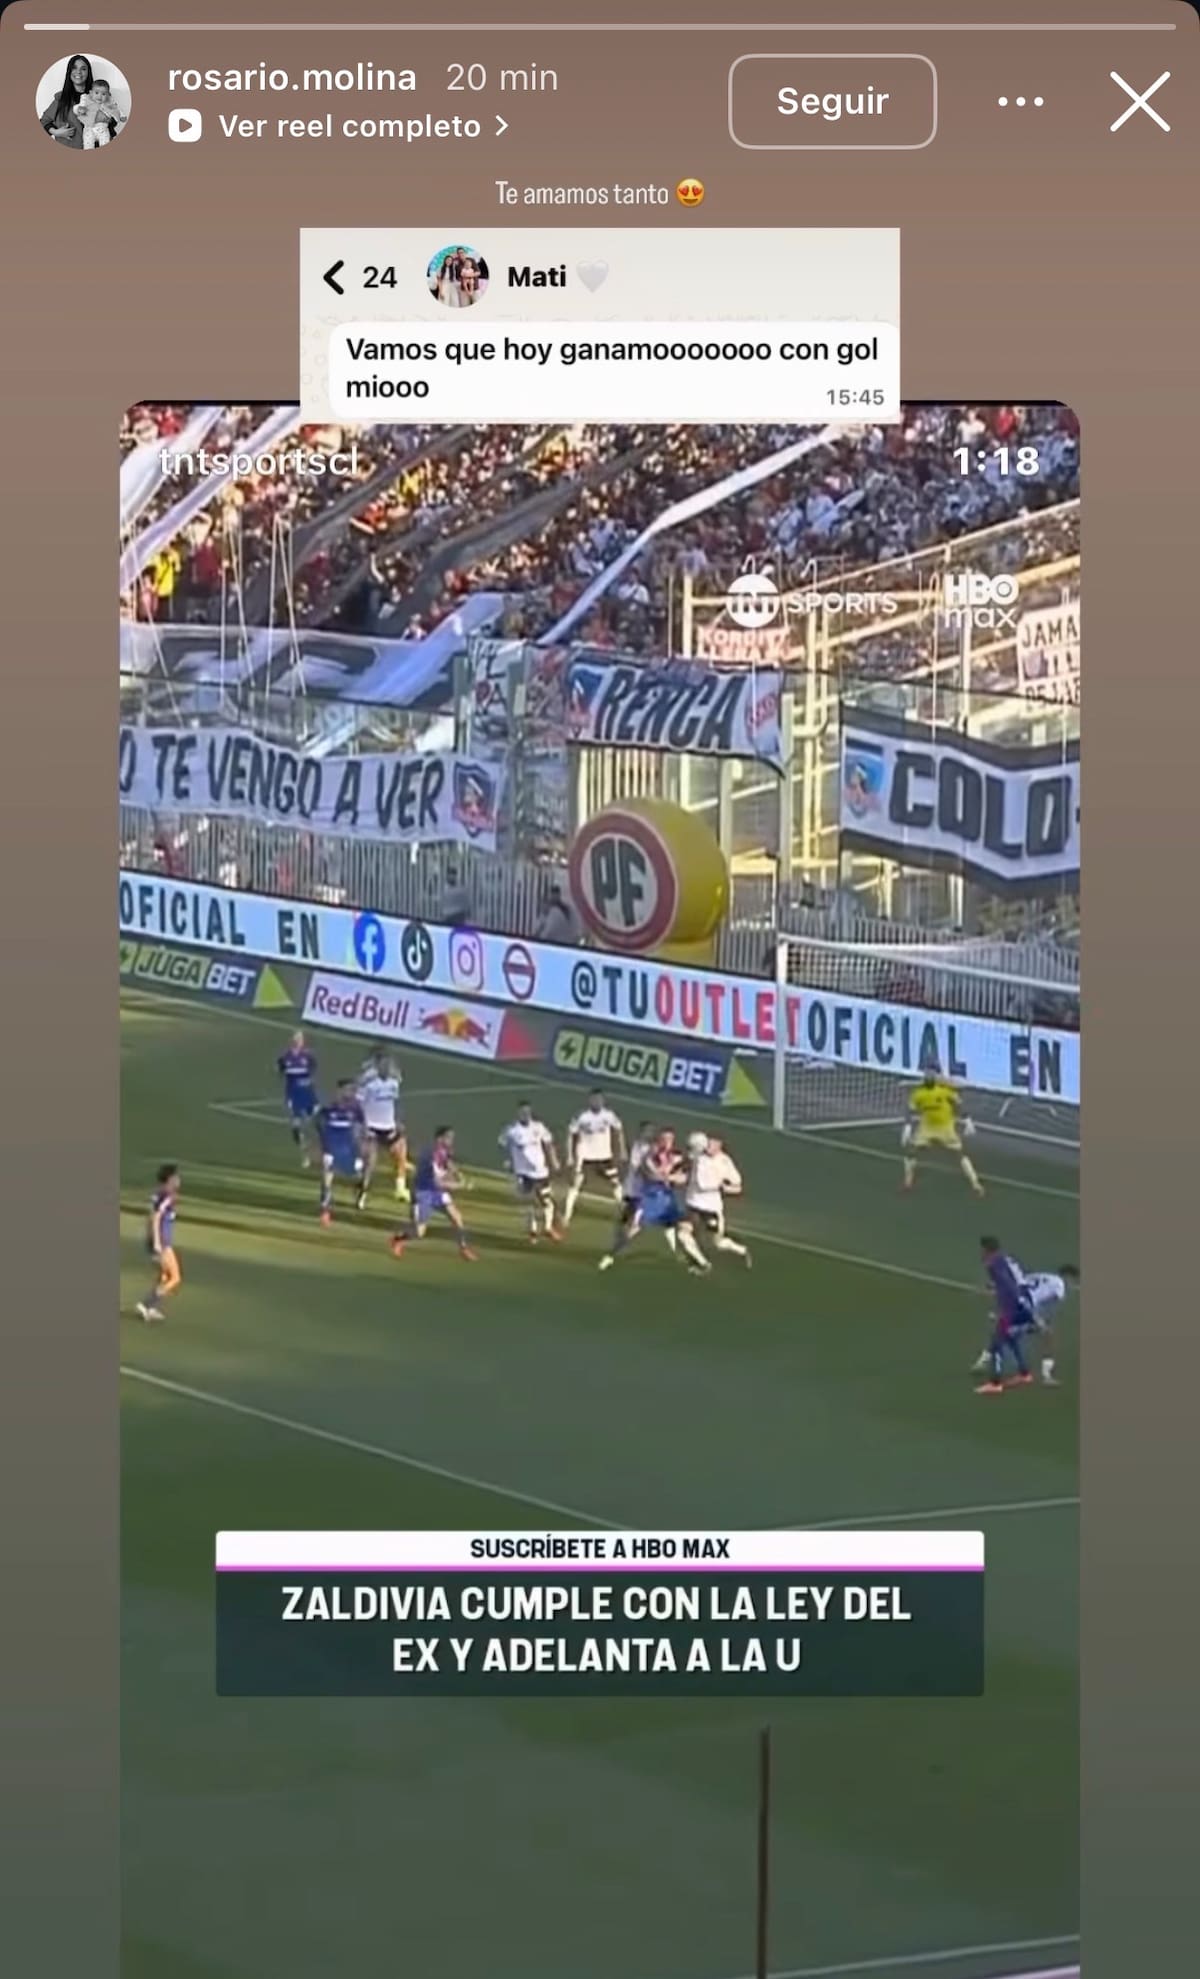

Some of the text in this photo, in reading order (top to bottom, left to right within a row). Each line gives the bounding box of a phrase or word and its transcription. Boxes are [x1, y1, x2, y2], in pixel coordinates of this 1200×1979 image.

[594, 666, 748, 750] RENCA
[151, 734, 197, 799] TE
[207, 735, 324, 818] VENGO
[332, 760, 362, 825] A
[375, 758, 446, 829] VER
[120, 881, 246, 946] OFICIAL
[277, 910, 320, 960] EN
[1010, 1034, 1062, 1095] EN
